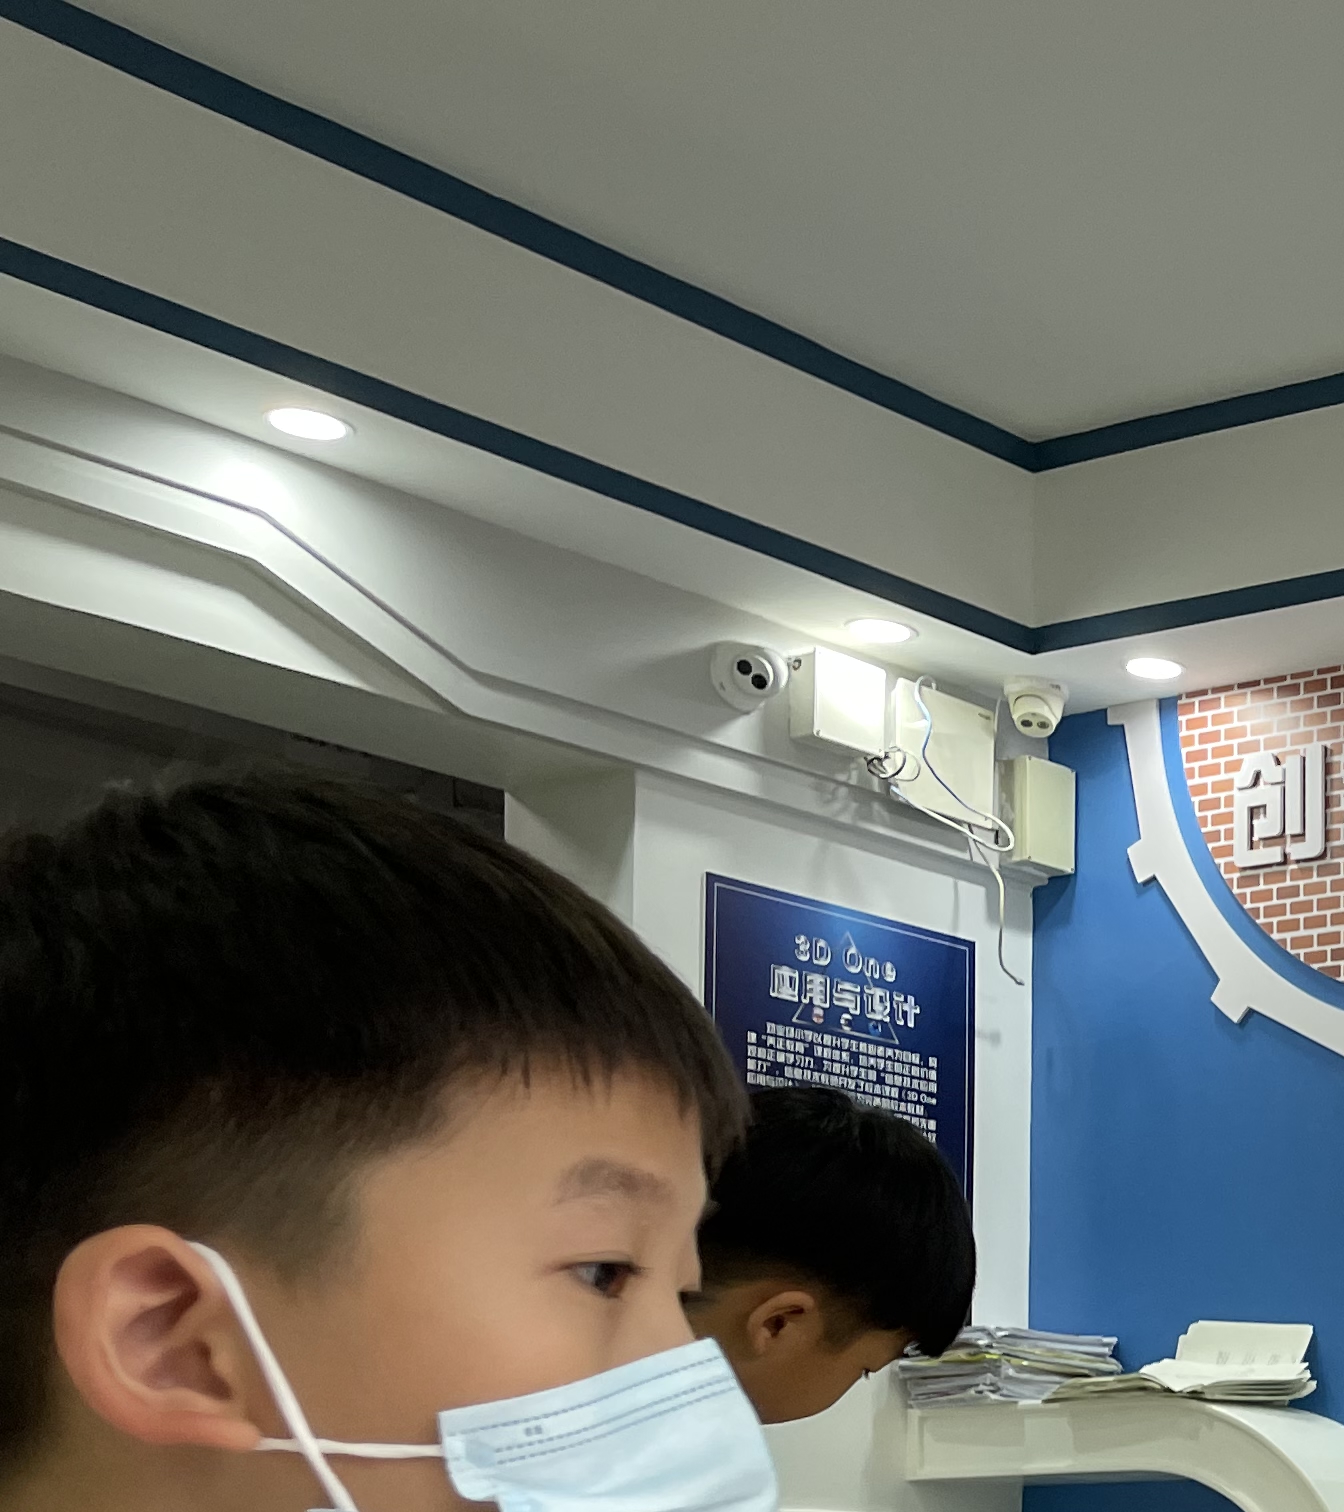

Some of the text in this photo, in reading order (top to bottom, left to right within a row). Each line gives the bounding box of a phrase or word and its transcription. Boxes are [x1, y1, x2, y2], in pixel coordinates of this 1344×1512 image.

[794, 934, 897, 983] 3D One
[769, 963, 921, 1028] 应用与设计
